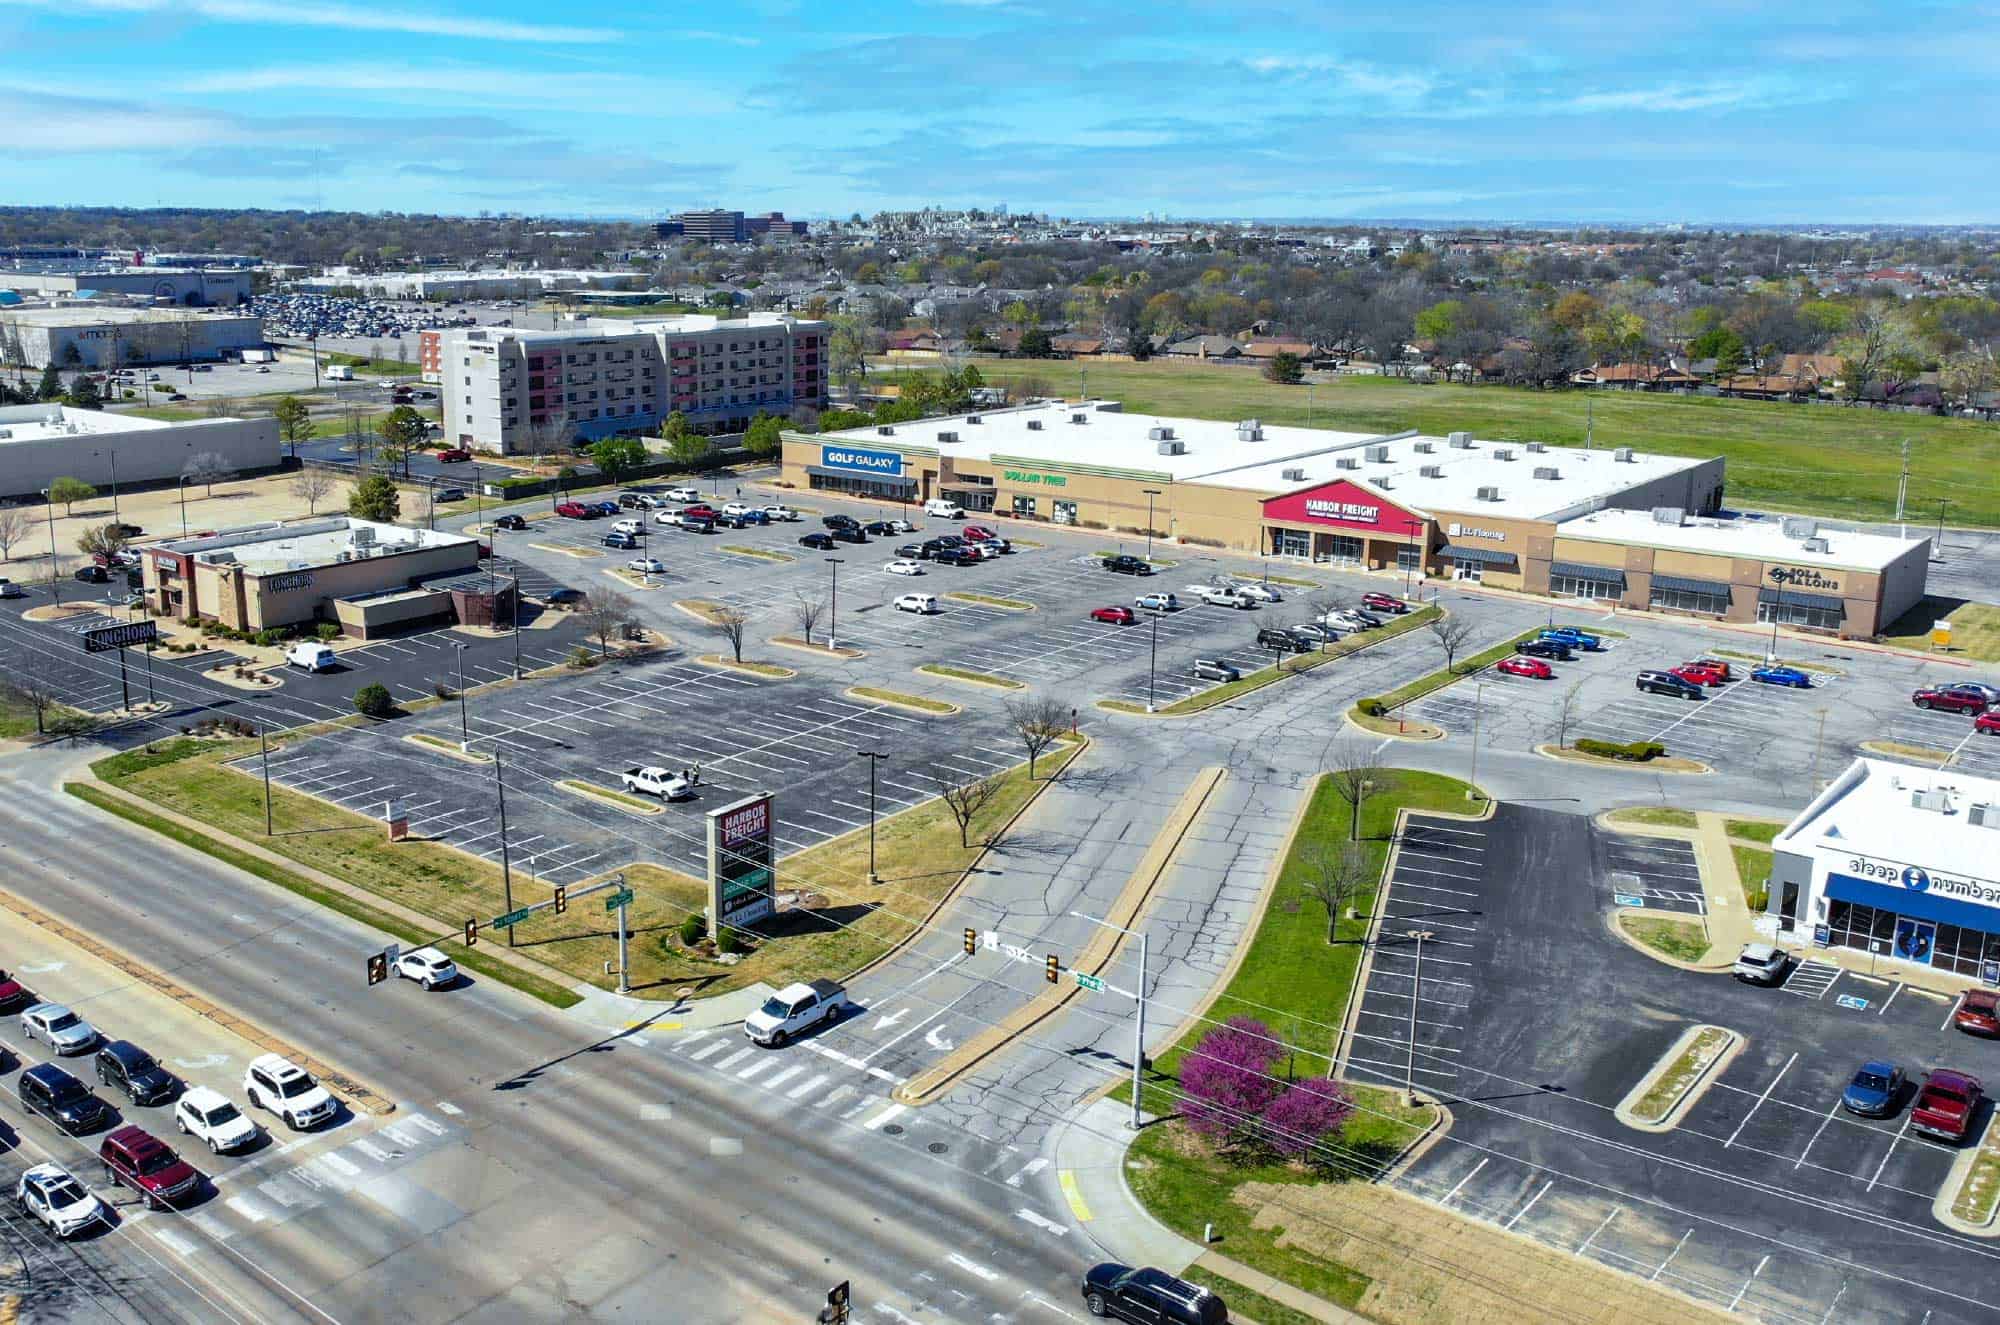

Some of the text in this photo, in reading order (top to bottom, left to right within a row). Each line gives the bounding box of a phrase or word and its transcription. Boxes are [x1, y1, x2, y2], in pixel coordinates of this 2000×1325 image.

[828, 452, 893, 469] GOLF GALAXY
[1306, 499, 1340, 512] HARBOR
[1342, 503, 1378, 517] FREIGHT
[89, 622, 155, 647] LONGHORN
[725, 805, 766, 829] HARBOR
[725, 816, 766, 842] FREIGHT
[1850, 858, 1898, 882] sleep
